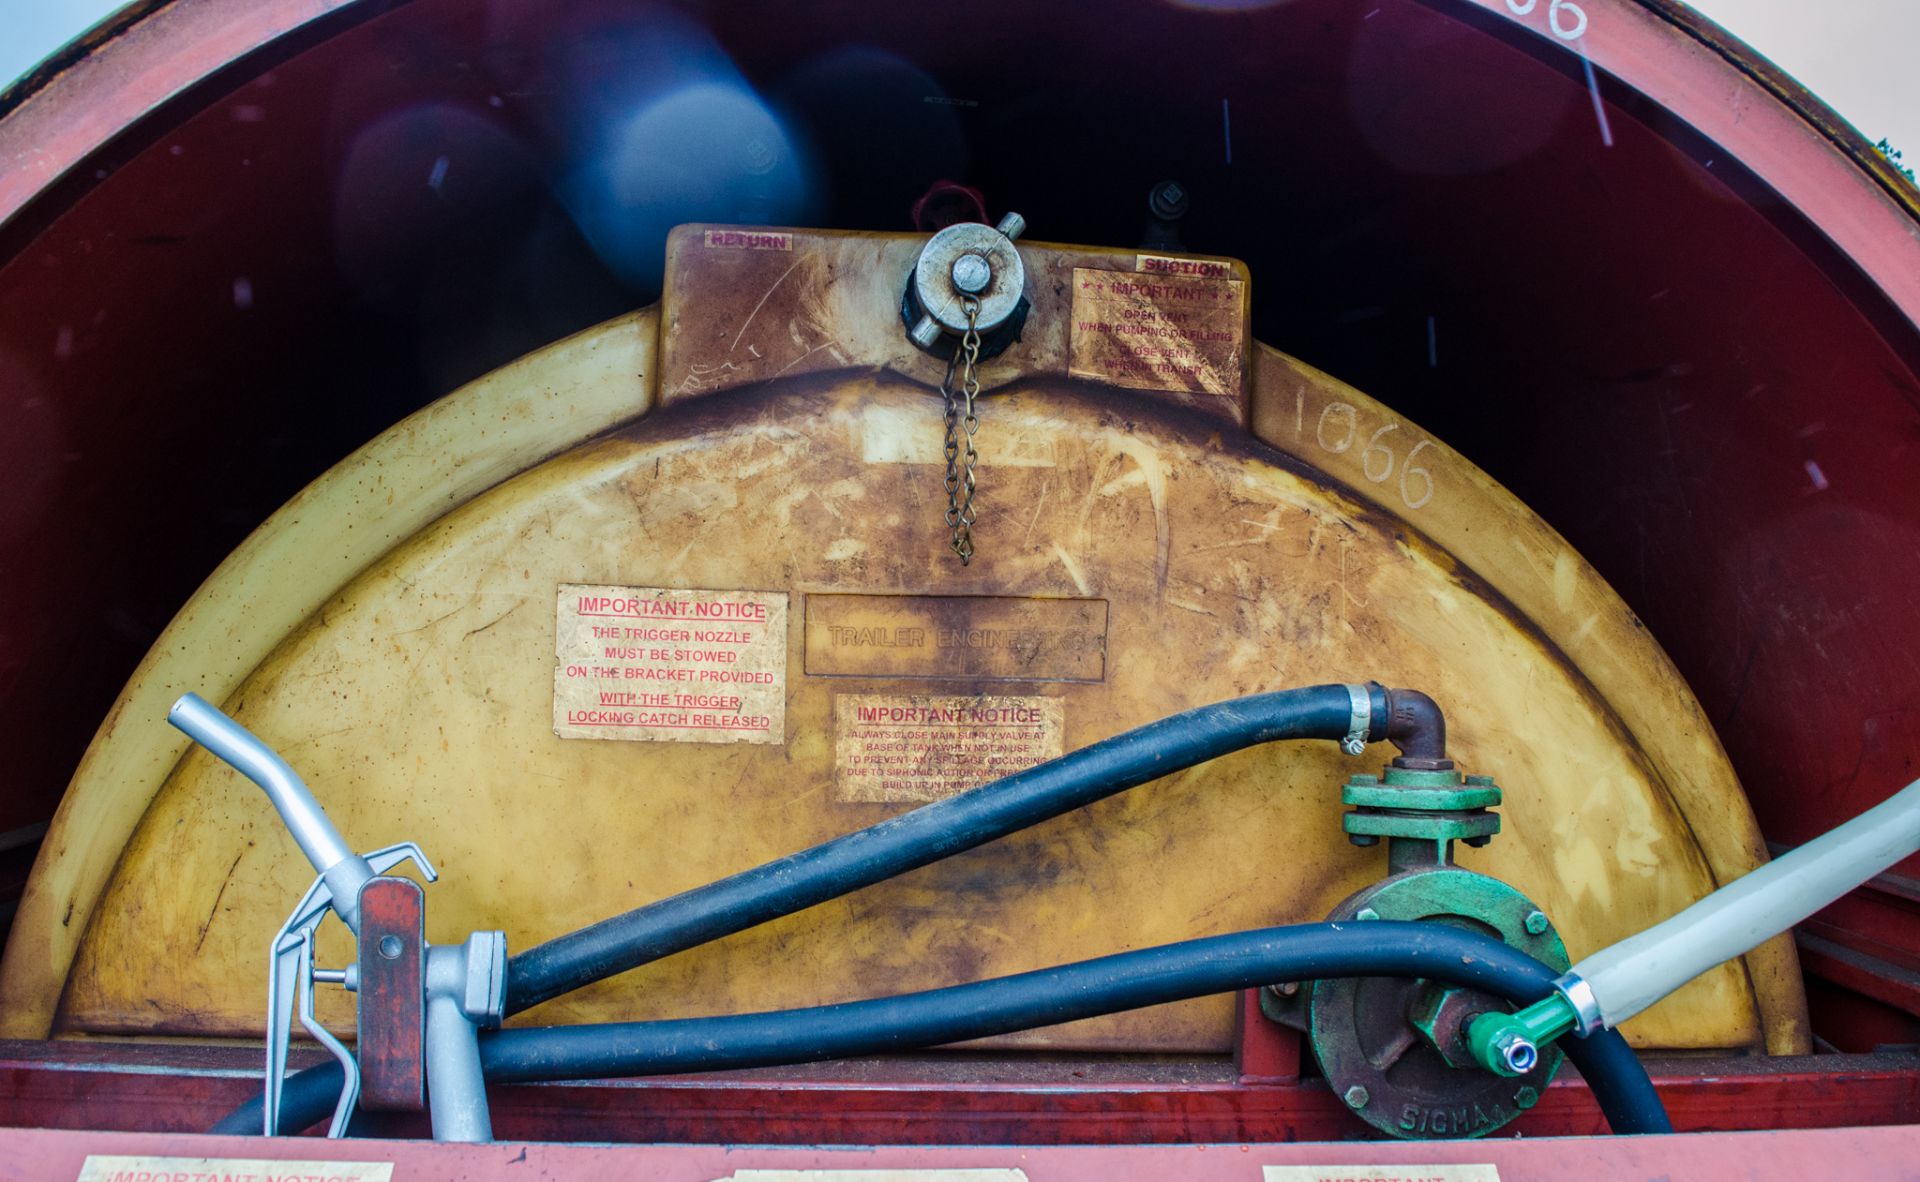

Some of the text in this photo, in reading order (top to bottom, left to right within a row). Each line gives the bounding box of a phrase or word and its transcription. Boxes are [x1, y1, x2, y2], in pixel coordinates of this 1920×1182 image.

[711, 233, 786, 249] RETURN
[1145, 258, 1224, 277] SUCTION
[1111, 282, 1205, 300] IMPORTANT
[1124, 309, 1187, 323] OPEN VENT
[1078, 322, 1233, 342] WHEN PUMPING OR FILLING
[1119, 345, 1189, 359] CLOSE VENT
[1104, 359, 1139, 371] WHEN
[1296, 386, 1438, 509] 1066
[578, 596, 766, 618] IMPORTANT NOTICE
[592, 626, 751, 644] THE TRIGGER NOZZLE
[828, 626, 925, 649] TRAILER
[605, 647, 737, 663] MUST BE STOWED
[566, 666, 774, 684] ON THE BRACKET PROVIDED
[600, 692, 740, 708] WITH THE TRIGGER
[568, 710, 770, 729] LOCKING CATCH RELEASED
[857, 706, 1041, 723] IMPORTANT NOTICE
[850, 730, 1046, 740] ALWAYS CLOSE MAIN SUPPLY VALVE AT
[866, 743, 1029, 753] BASE OF TANK WHEN NOT IN USE
[848, 755, 1047, 766] TO PREVENT ANY SPILLAGE OCCURRING
[847, 768, 868, 776] DUE
[872, 768, 884, 776] TO
[886, 768, 933, 777] SIPHONIC
[936, 768, 973, 777] ACTION
[976, 768, 990, 777] OR
[882, 780, 912, 789] BUILD
[915, 780, 928, 789] UP
[931, 781, 940, 789] IN
[944, 781, 971, 790] PUMP
[1399, 1103, 1489, 1135] SIGMA
